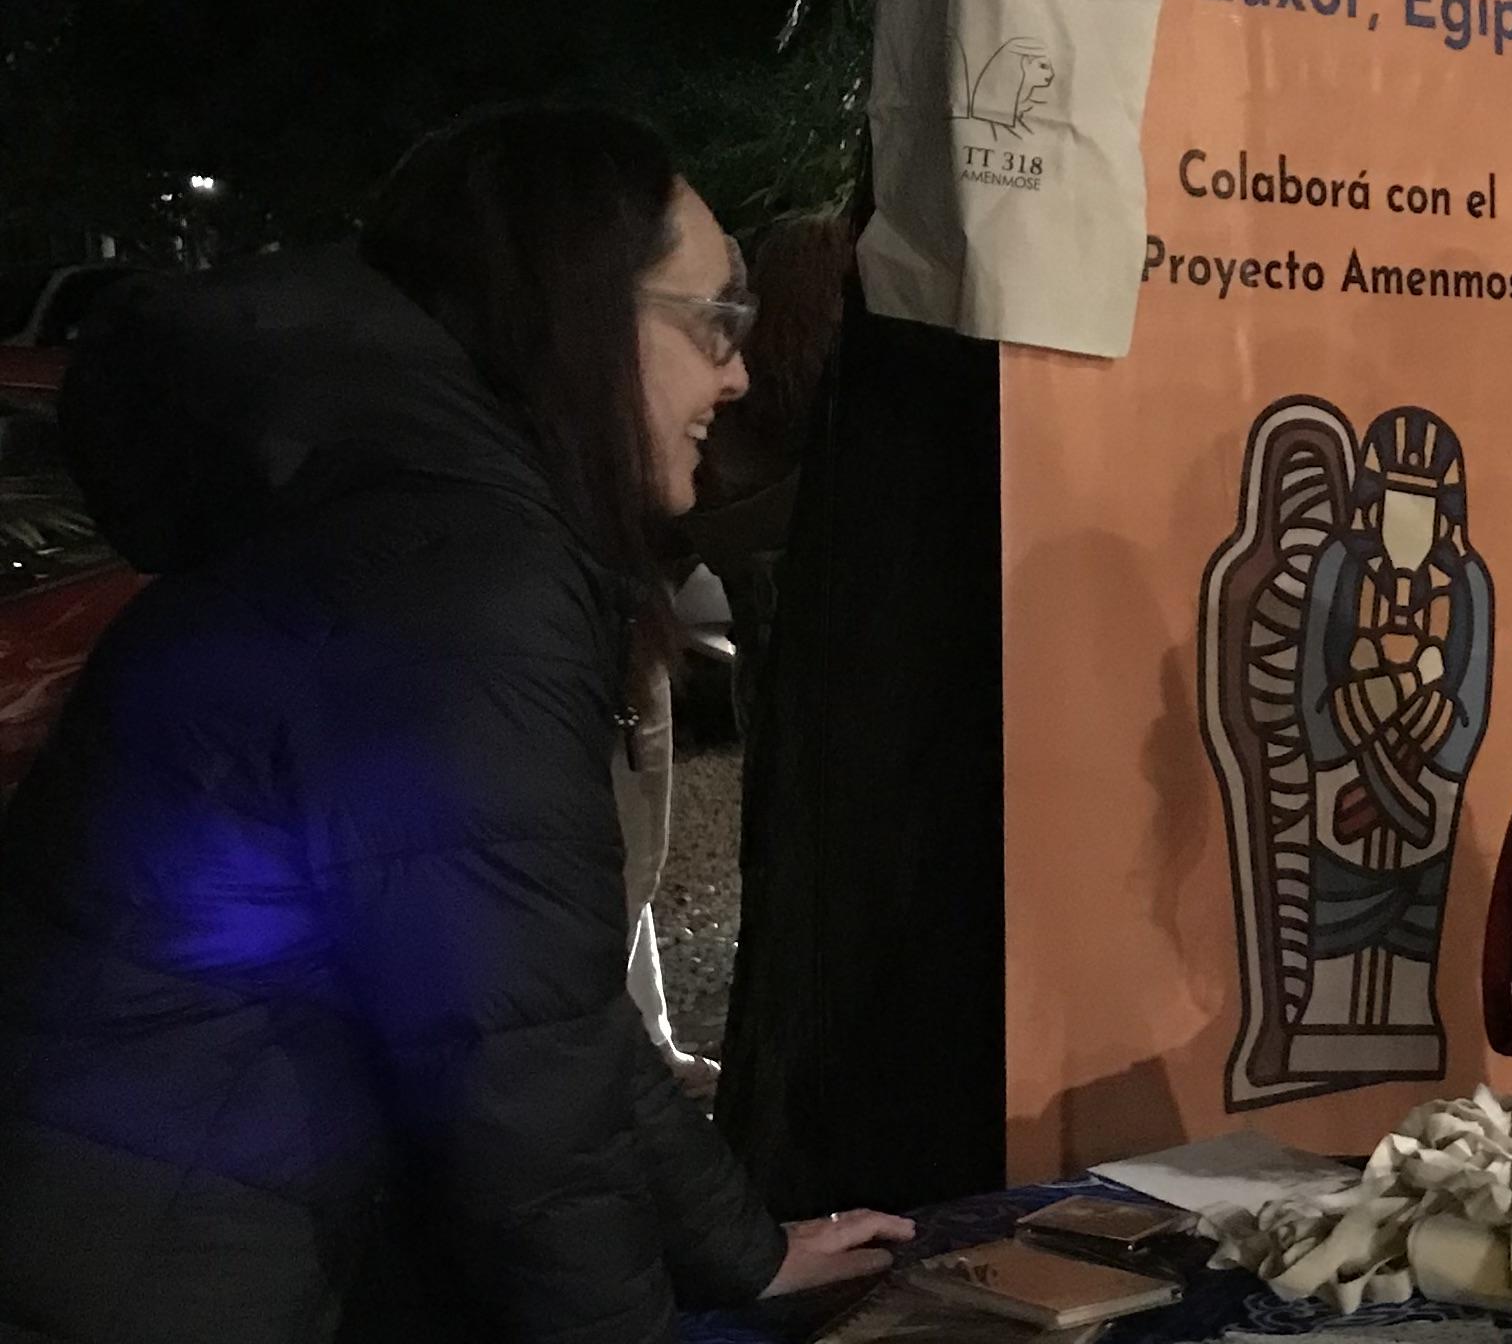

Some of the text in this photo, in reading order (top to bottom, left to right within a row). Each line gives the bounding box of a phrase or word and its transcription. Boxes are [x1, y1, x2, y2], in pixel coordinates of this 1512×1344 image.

[960, 169, 1042, 191] AMENMOSE
[962, 145, 1043, 176] TT 318
[1179, 148, 1496, 219] Colaborá con el
[1141, 234, 1325, 300] Proyecto
